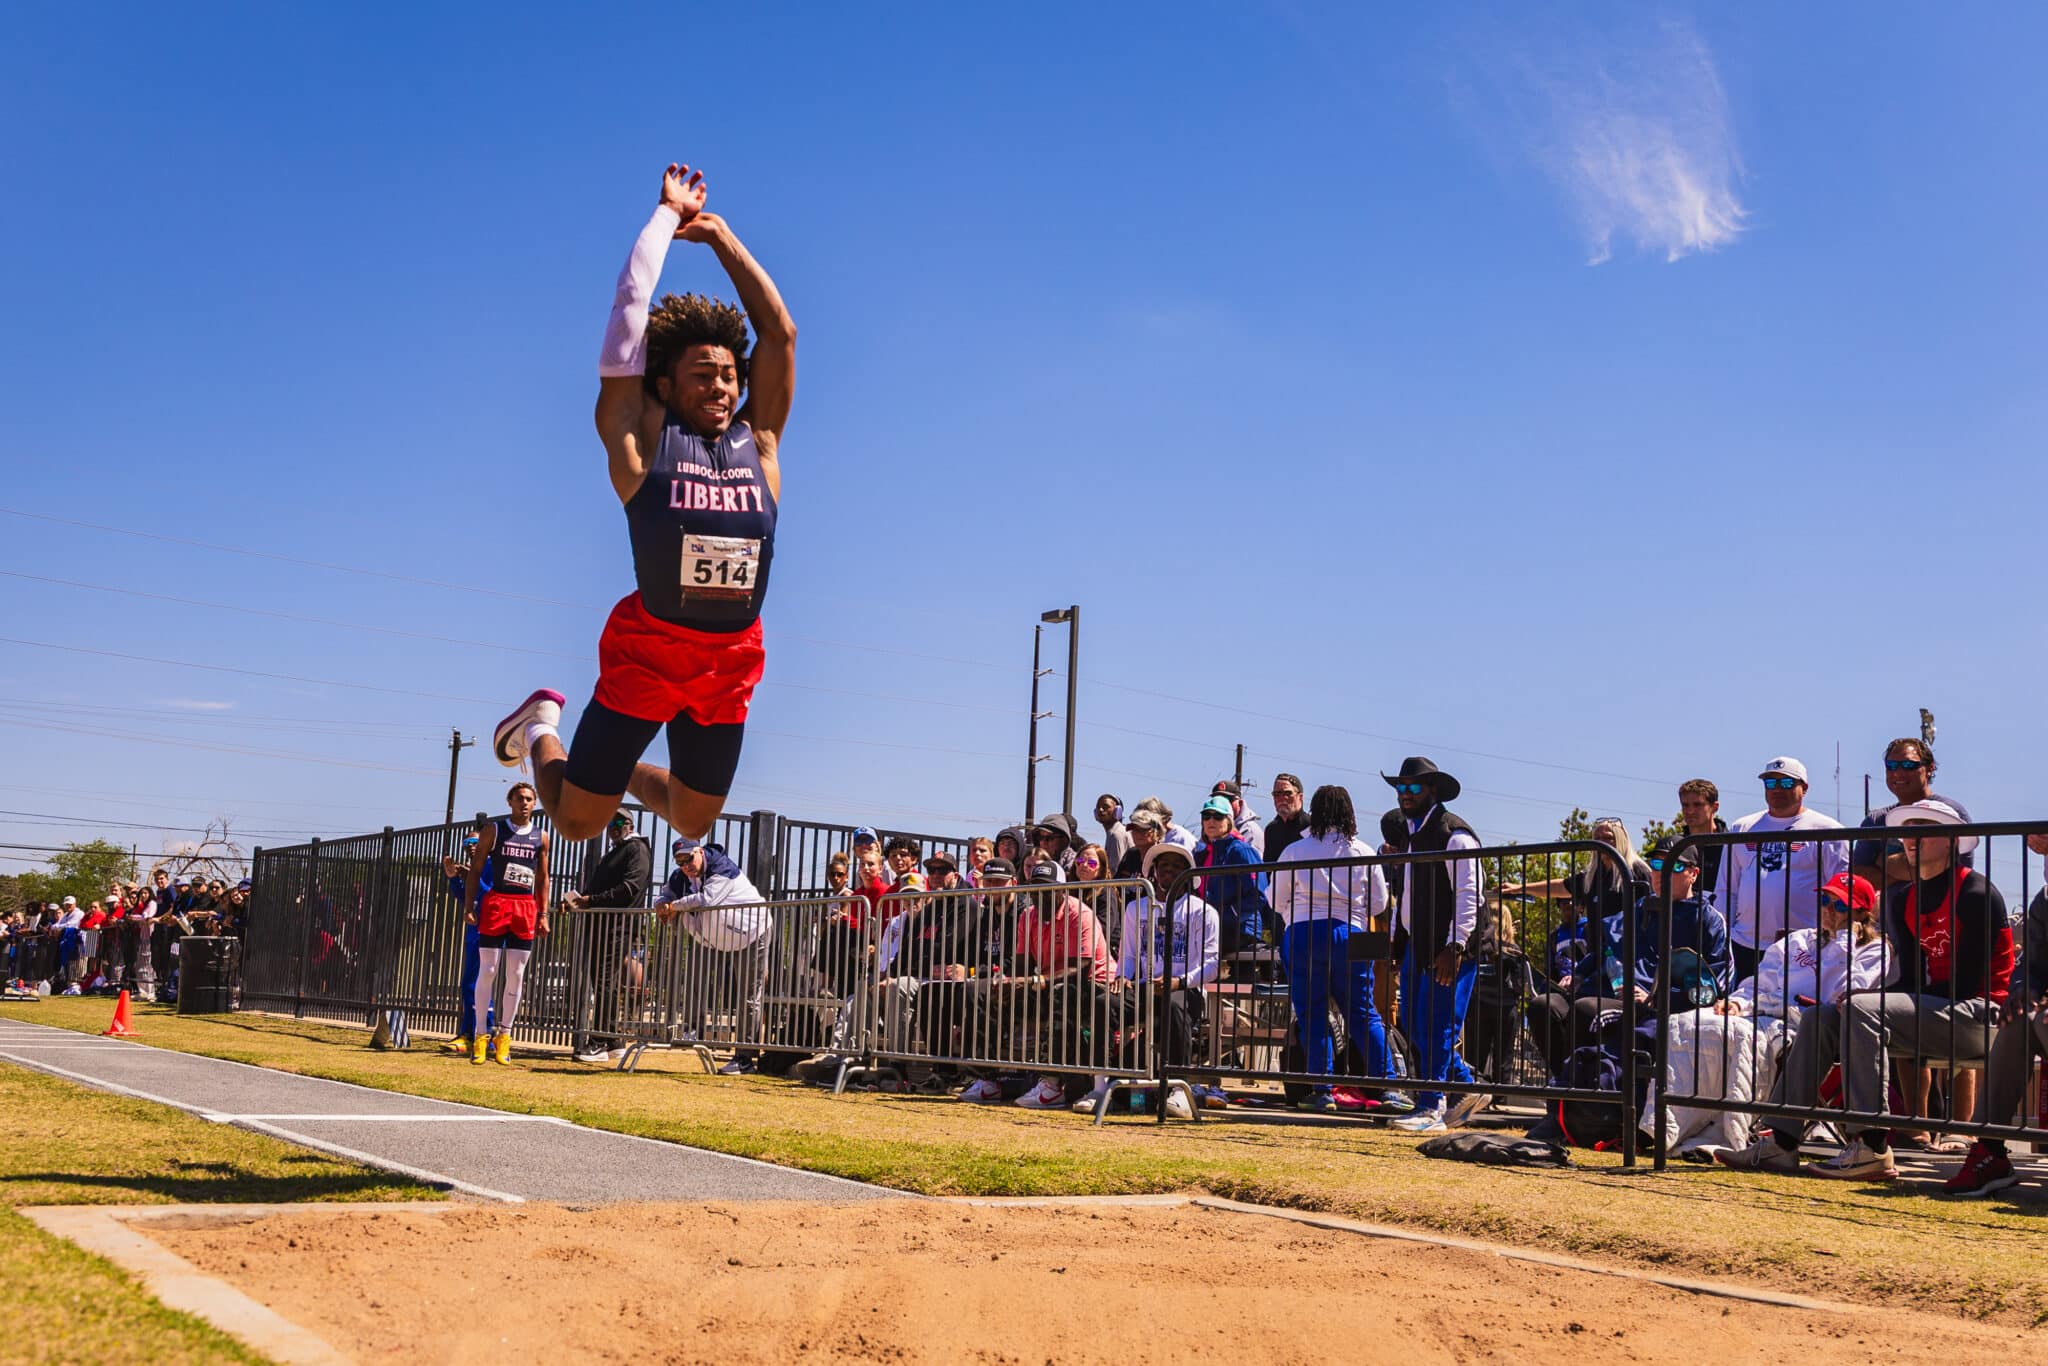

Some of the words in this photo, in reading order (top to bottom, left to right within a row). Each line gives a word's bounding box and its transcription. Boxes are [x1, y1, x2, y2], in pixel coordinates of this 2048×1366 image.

[669, 480, 763, 512] LIBERTY
[693, 558, 749, 586] 514
[501, 846, 536, 859] LIBERTY
[509, 872, 529, 884] 513
